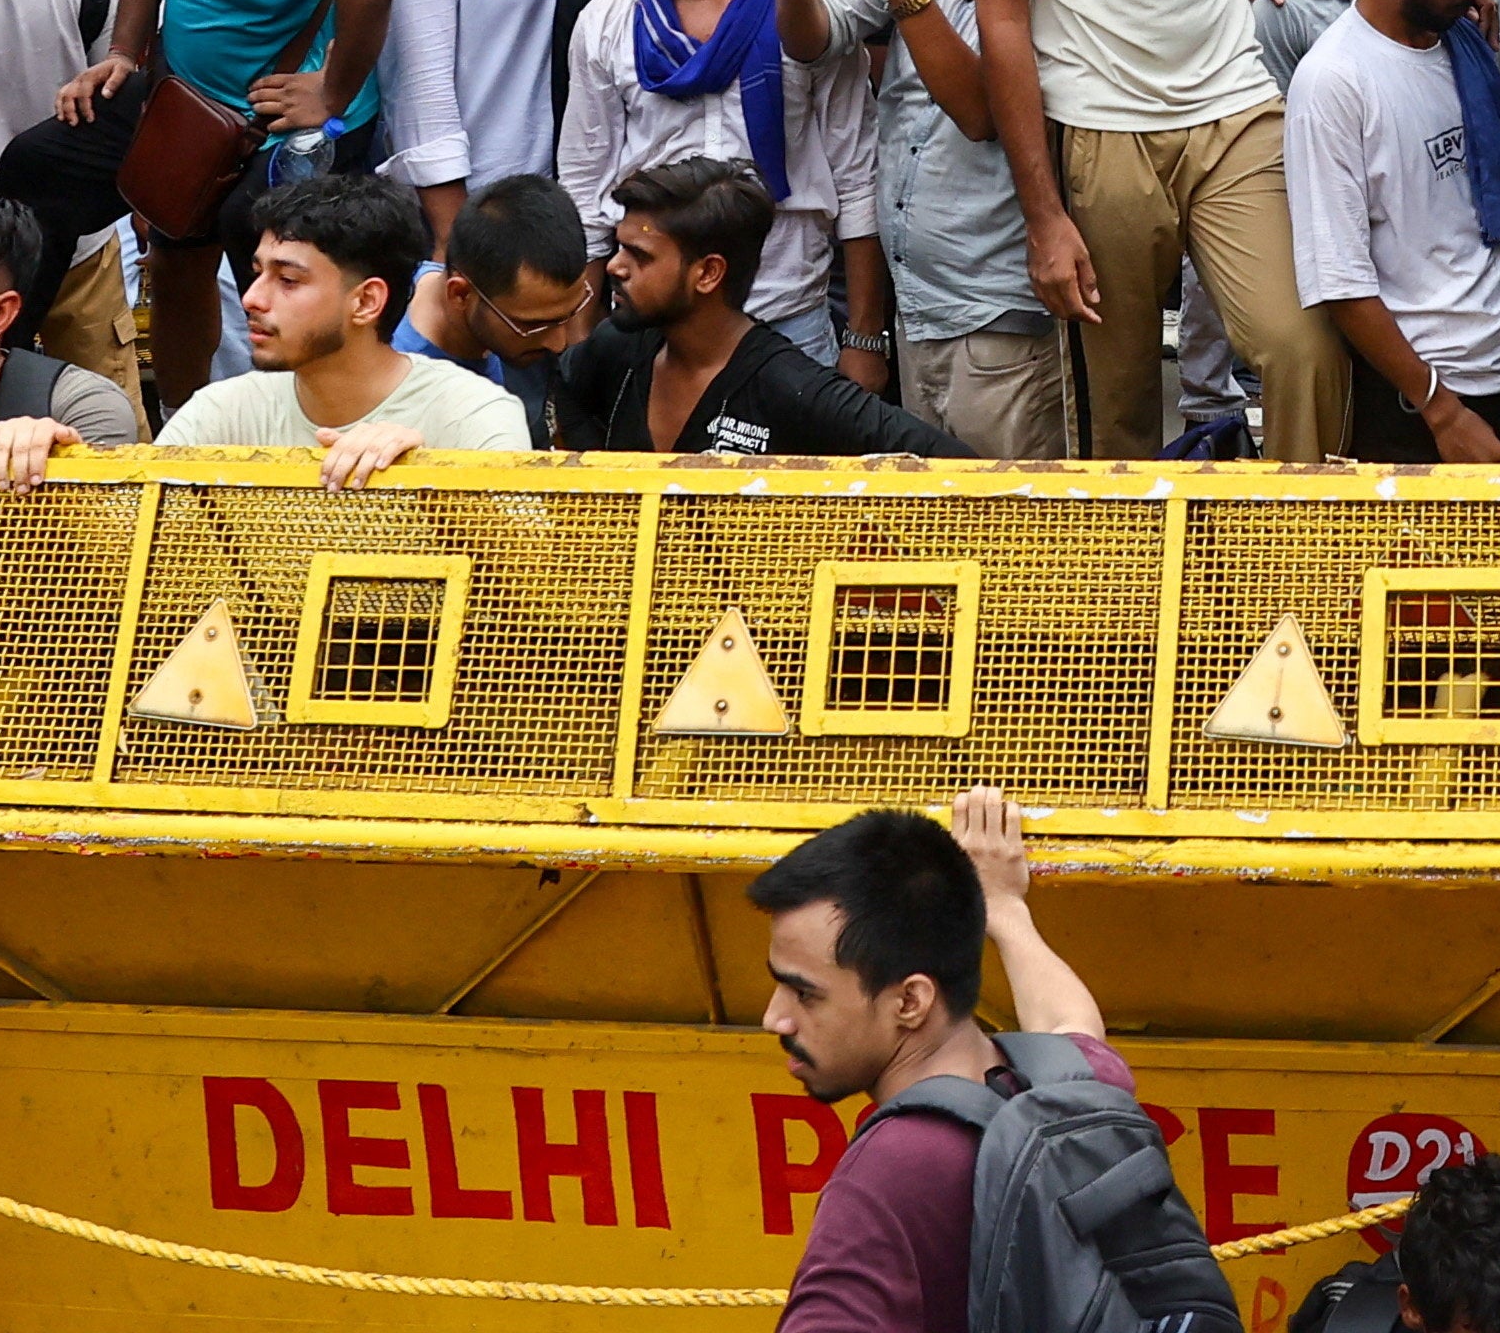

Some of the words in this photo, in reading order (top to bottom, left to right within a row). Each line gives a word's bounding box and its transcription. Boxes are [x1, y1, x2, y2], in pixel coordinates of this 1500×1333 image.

[1434, 133, 1463, 160] Lev
[717, 429, 761, 450] PRODUCT
[203, 1076, 671, 1230] DELHI
